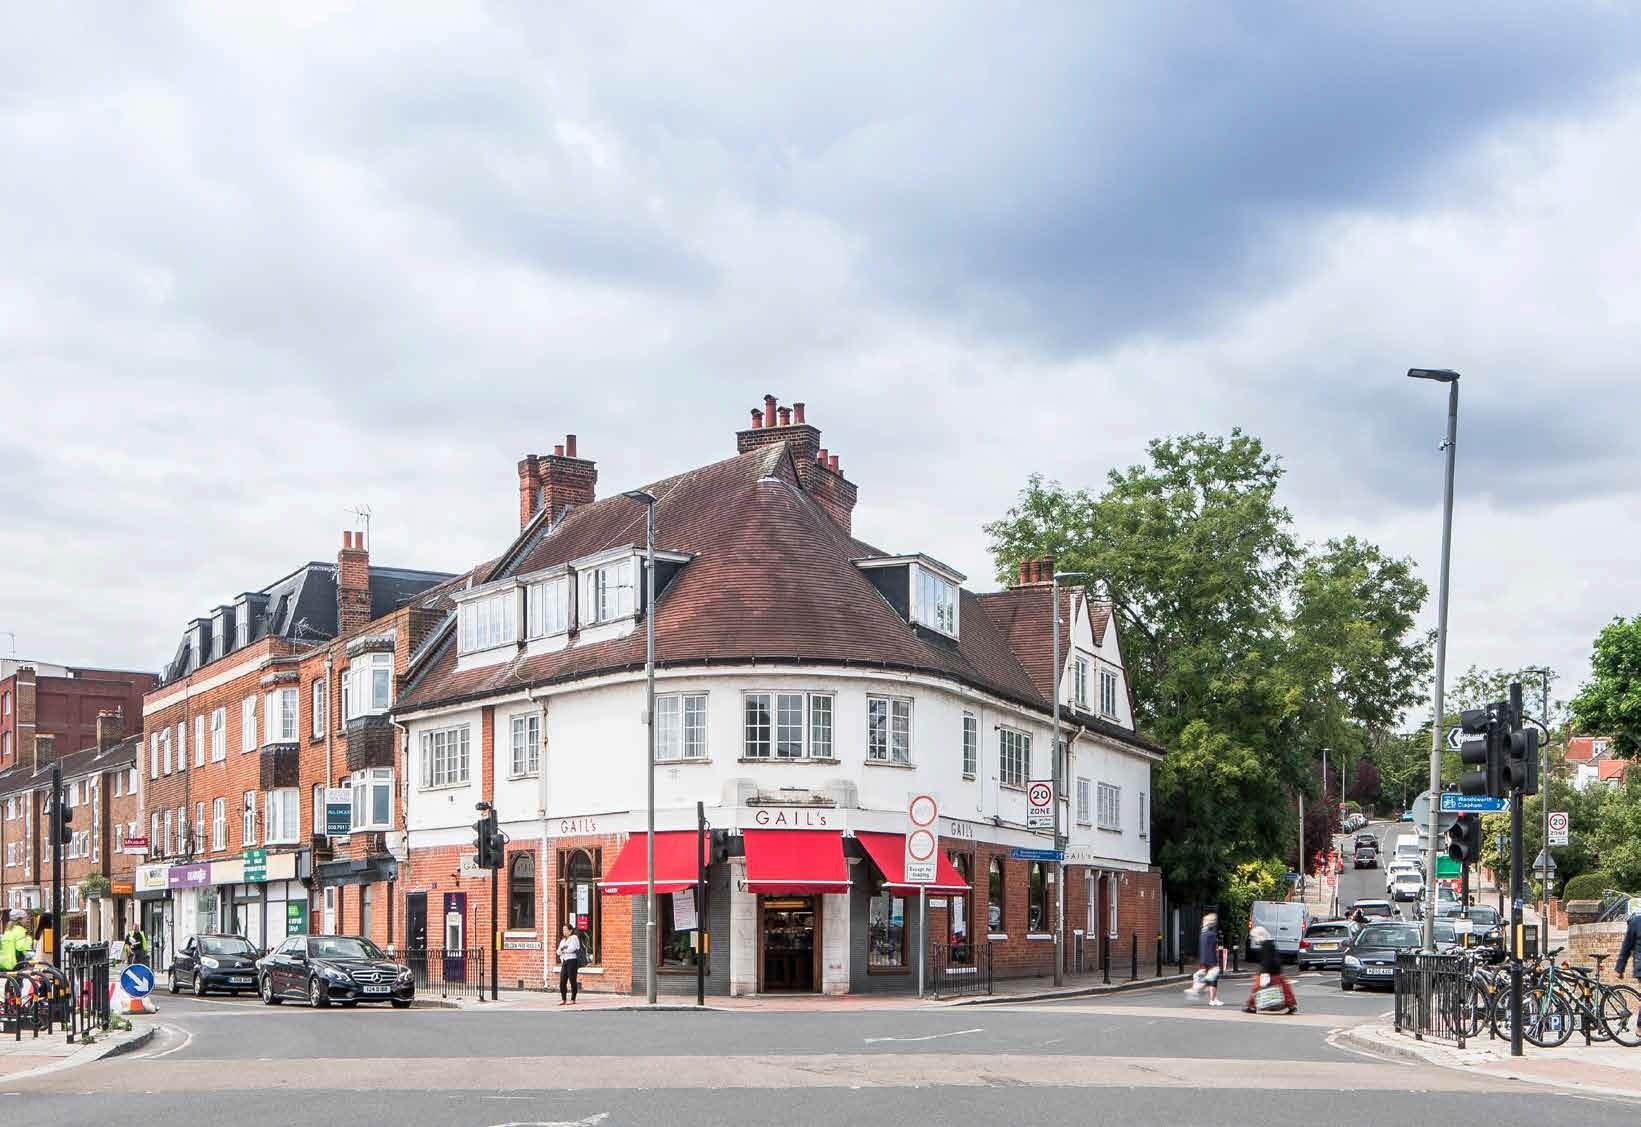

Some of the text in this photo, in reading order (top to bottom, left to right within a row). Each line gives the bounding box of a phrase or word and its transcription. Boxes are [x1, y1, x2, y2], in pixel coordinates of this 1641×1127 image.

[1033, 790, 1048, 800] 20
[755, 810, 827, 826] GAIL's
[1553, 818, 1565, 826] 20
[561, 817, 597, 834] GAIL's
